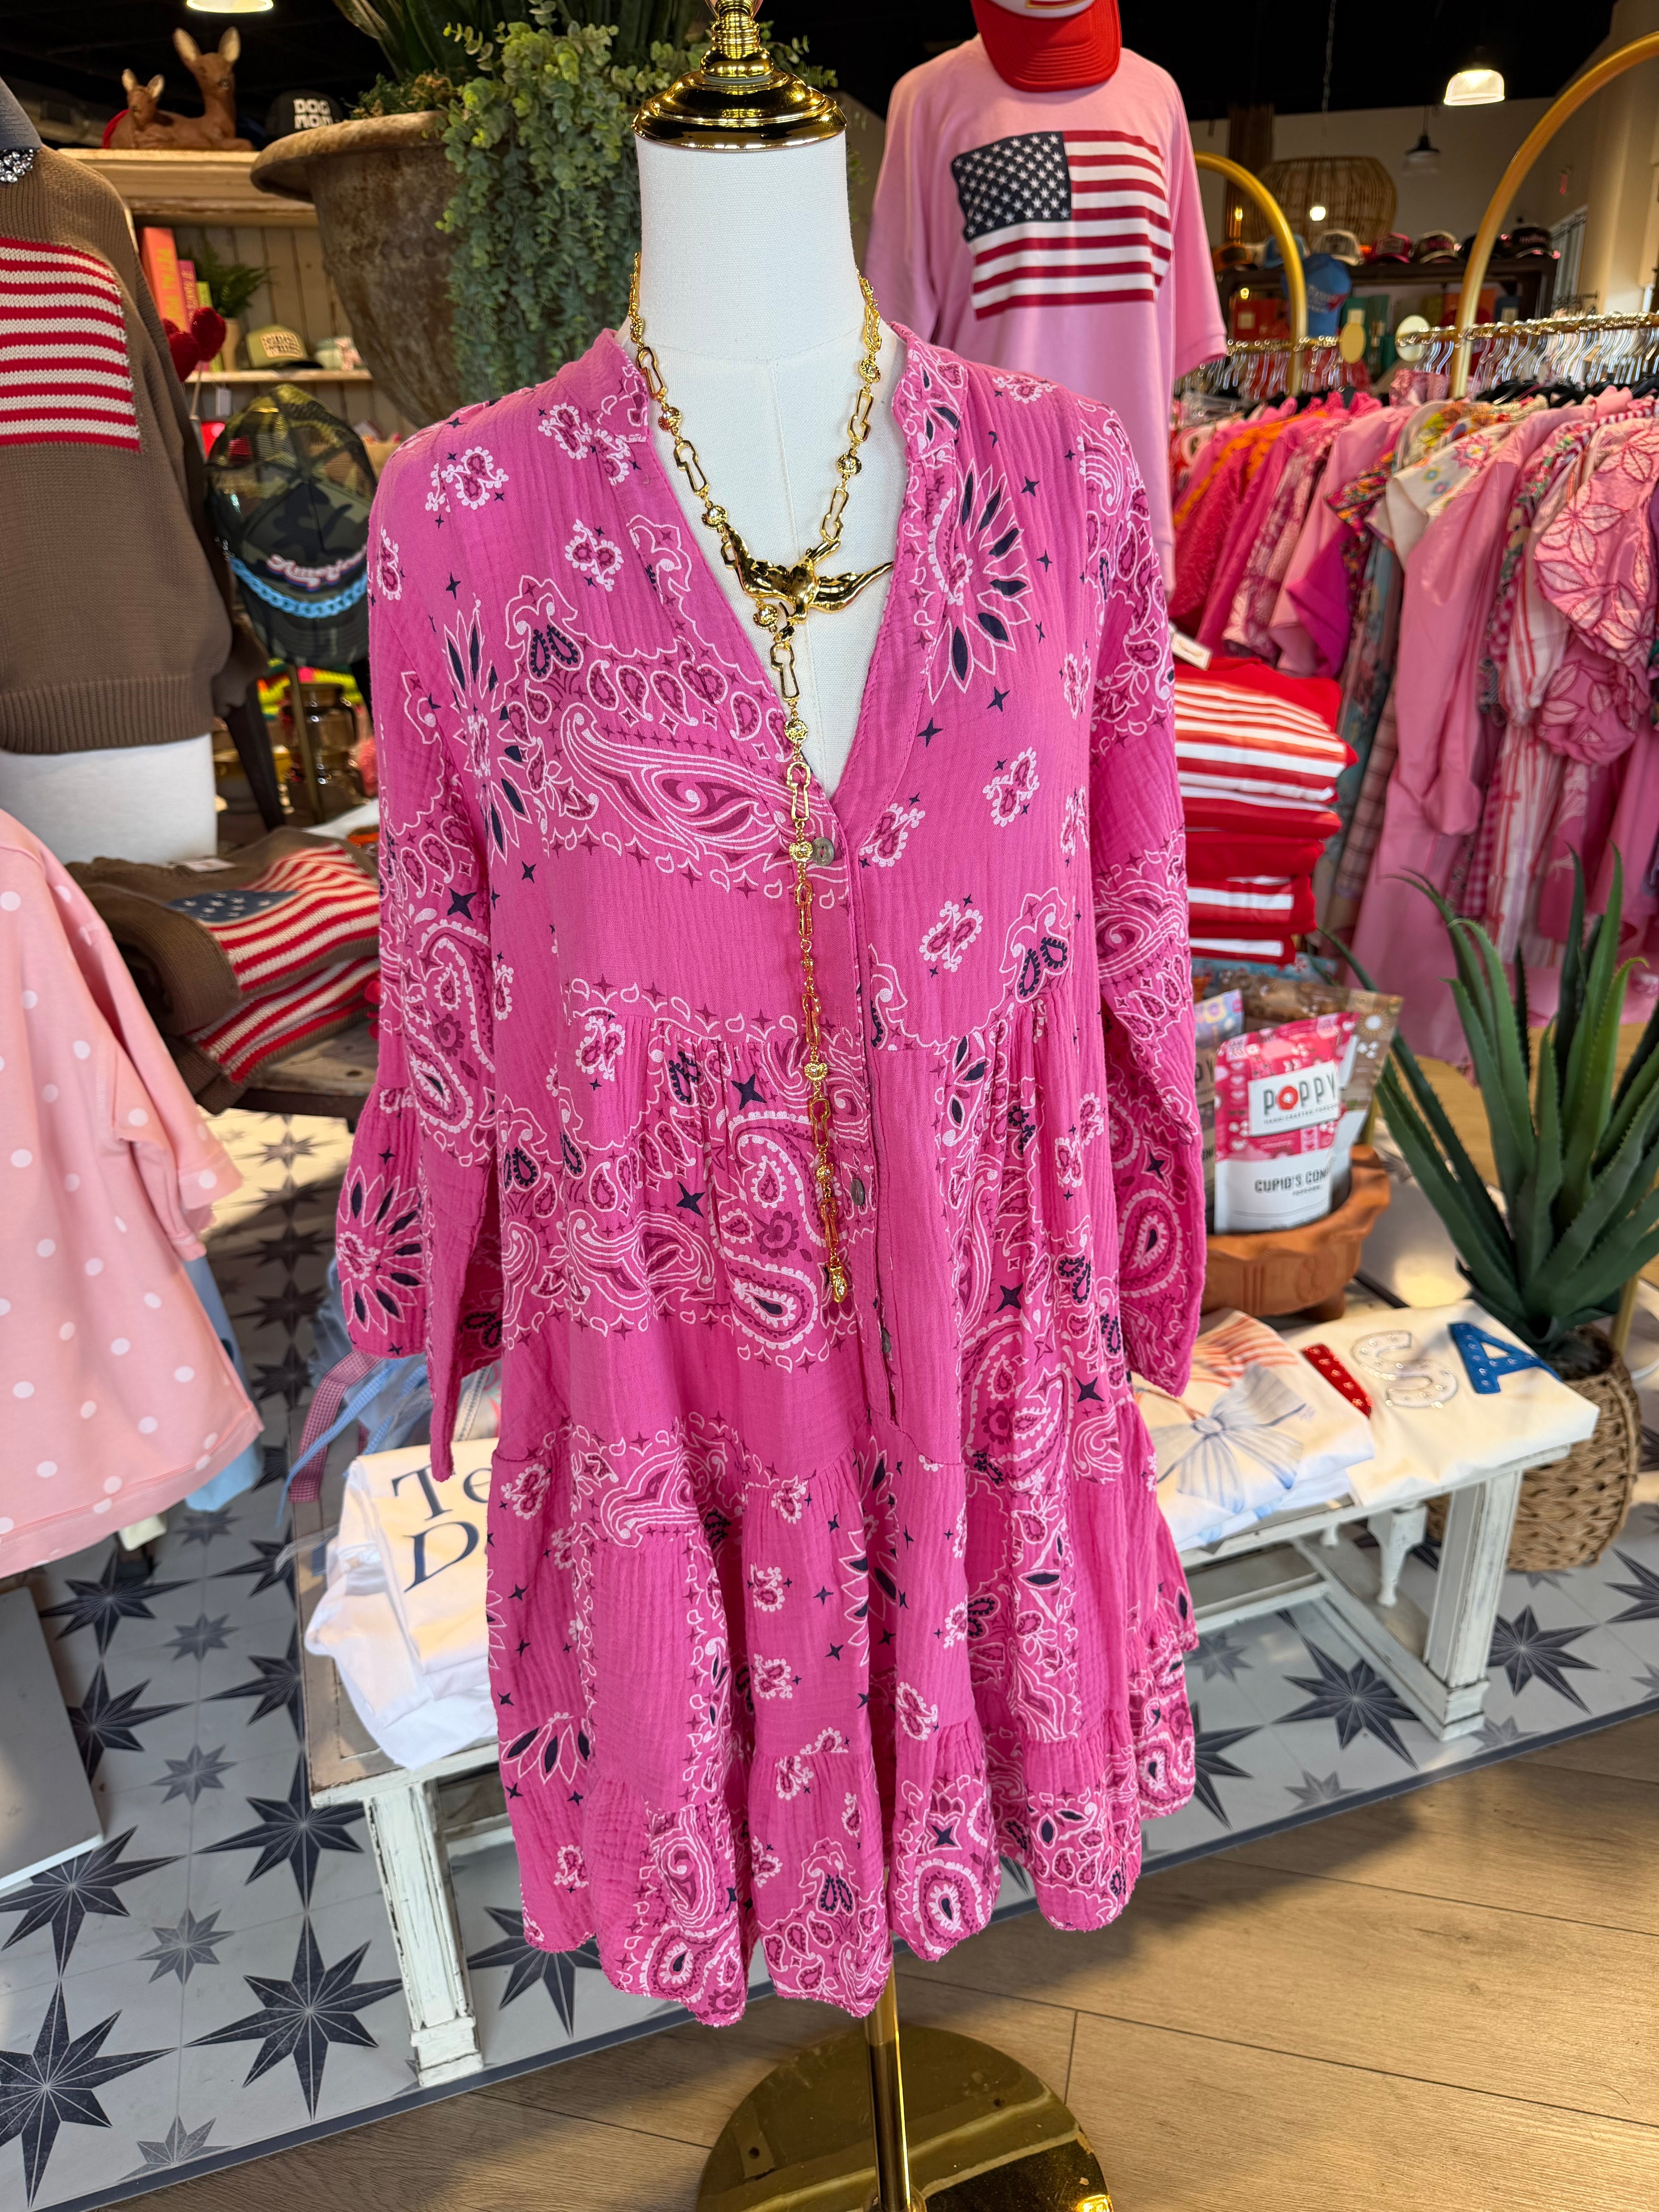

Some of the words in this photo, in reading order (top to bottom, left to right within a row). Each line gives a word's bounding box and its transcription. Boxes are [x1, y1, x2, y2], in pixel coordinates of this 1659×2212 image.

[293, 98, 331, 116] DOG
[294, 114, 333, 130] MOM
[1263, 1072, 1336, 1116] POPPY
[1254, 1173, 1302, 1193] CUPID'S
[401, 1520, 487, 1593] D
